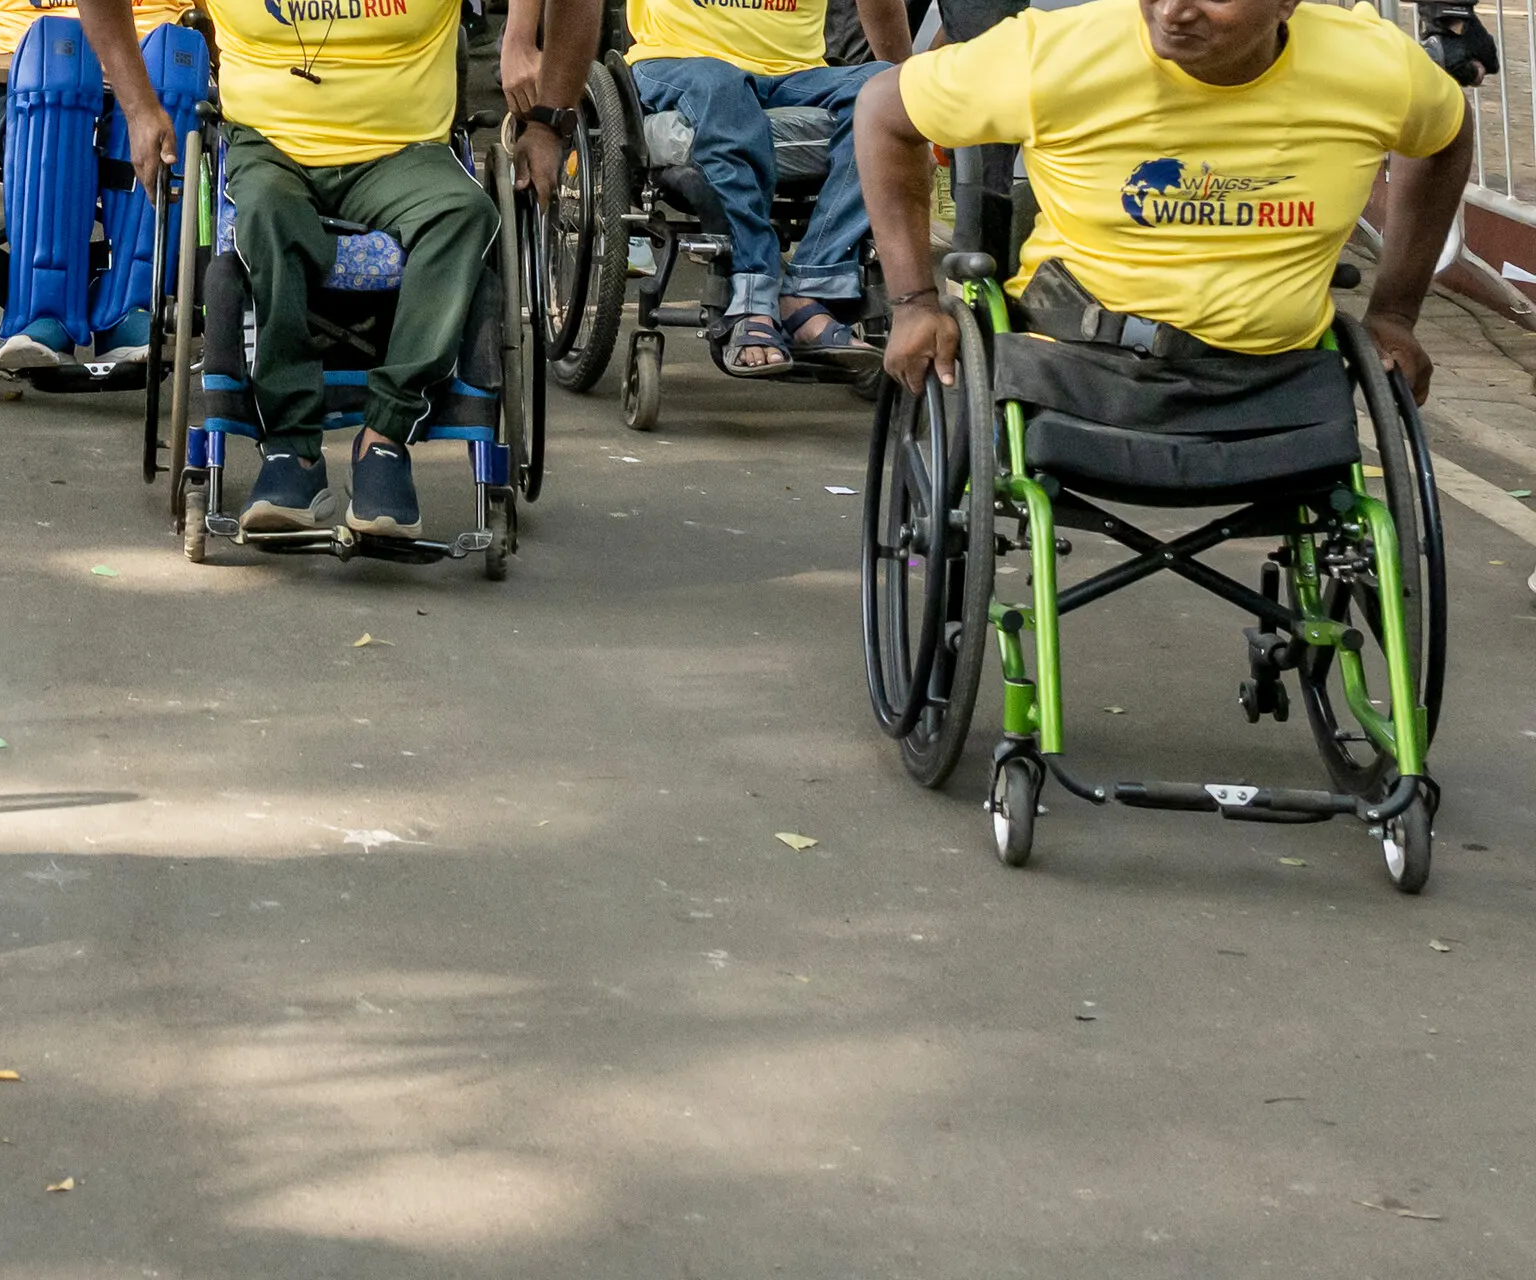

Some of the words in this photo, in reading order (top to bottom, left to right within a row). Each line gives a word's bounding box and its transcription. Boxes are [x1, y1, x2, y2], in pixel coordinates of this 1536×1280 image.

[1182, 175, 1252, 191] WINGS
[1190, 189, 1231, 202] LIFE
[1153, 200, 1255, 227] WORLD
[1257, 201, 1316, 228] RUN
